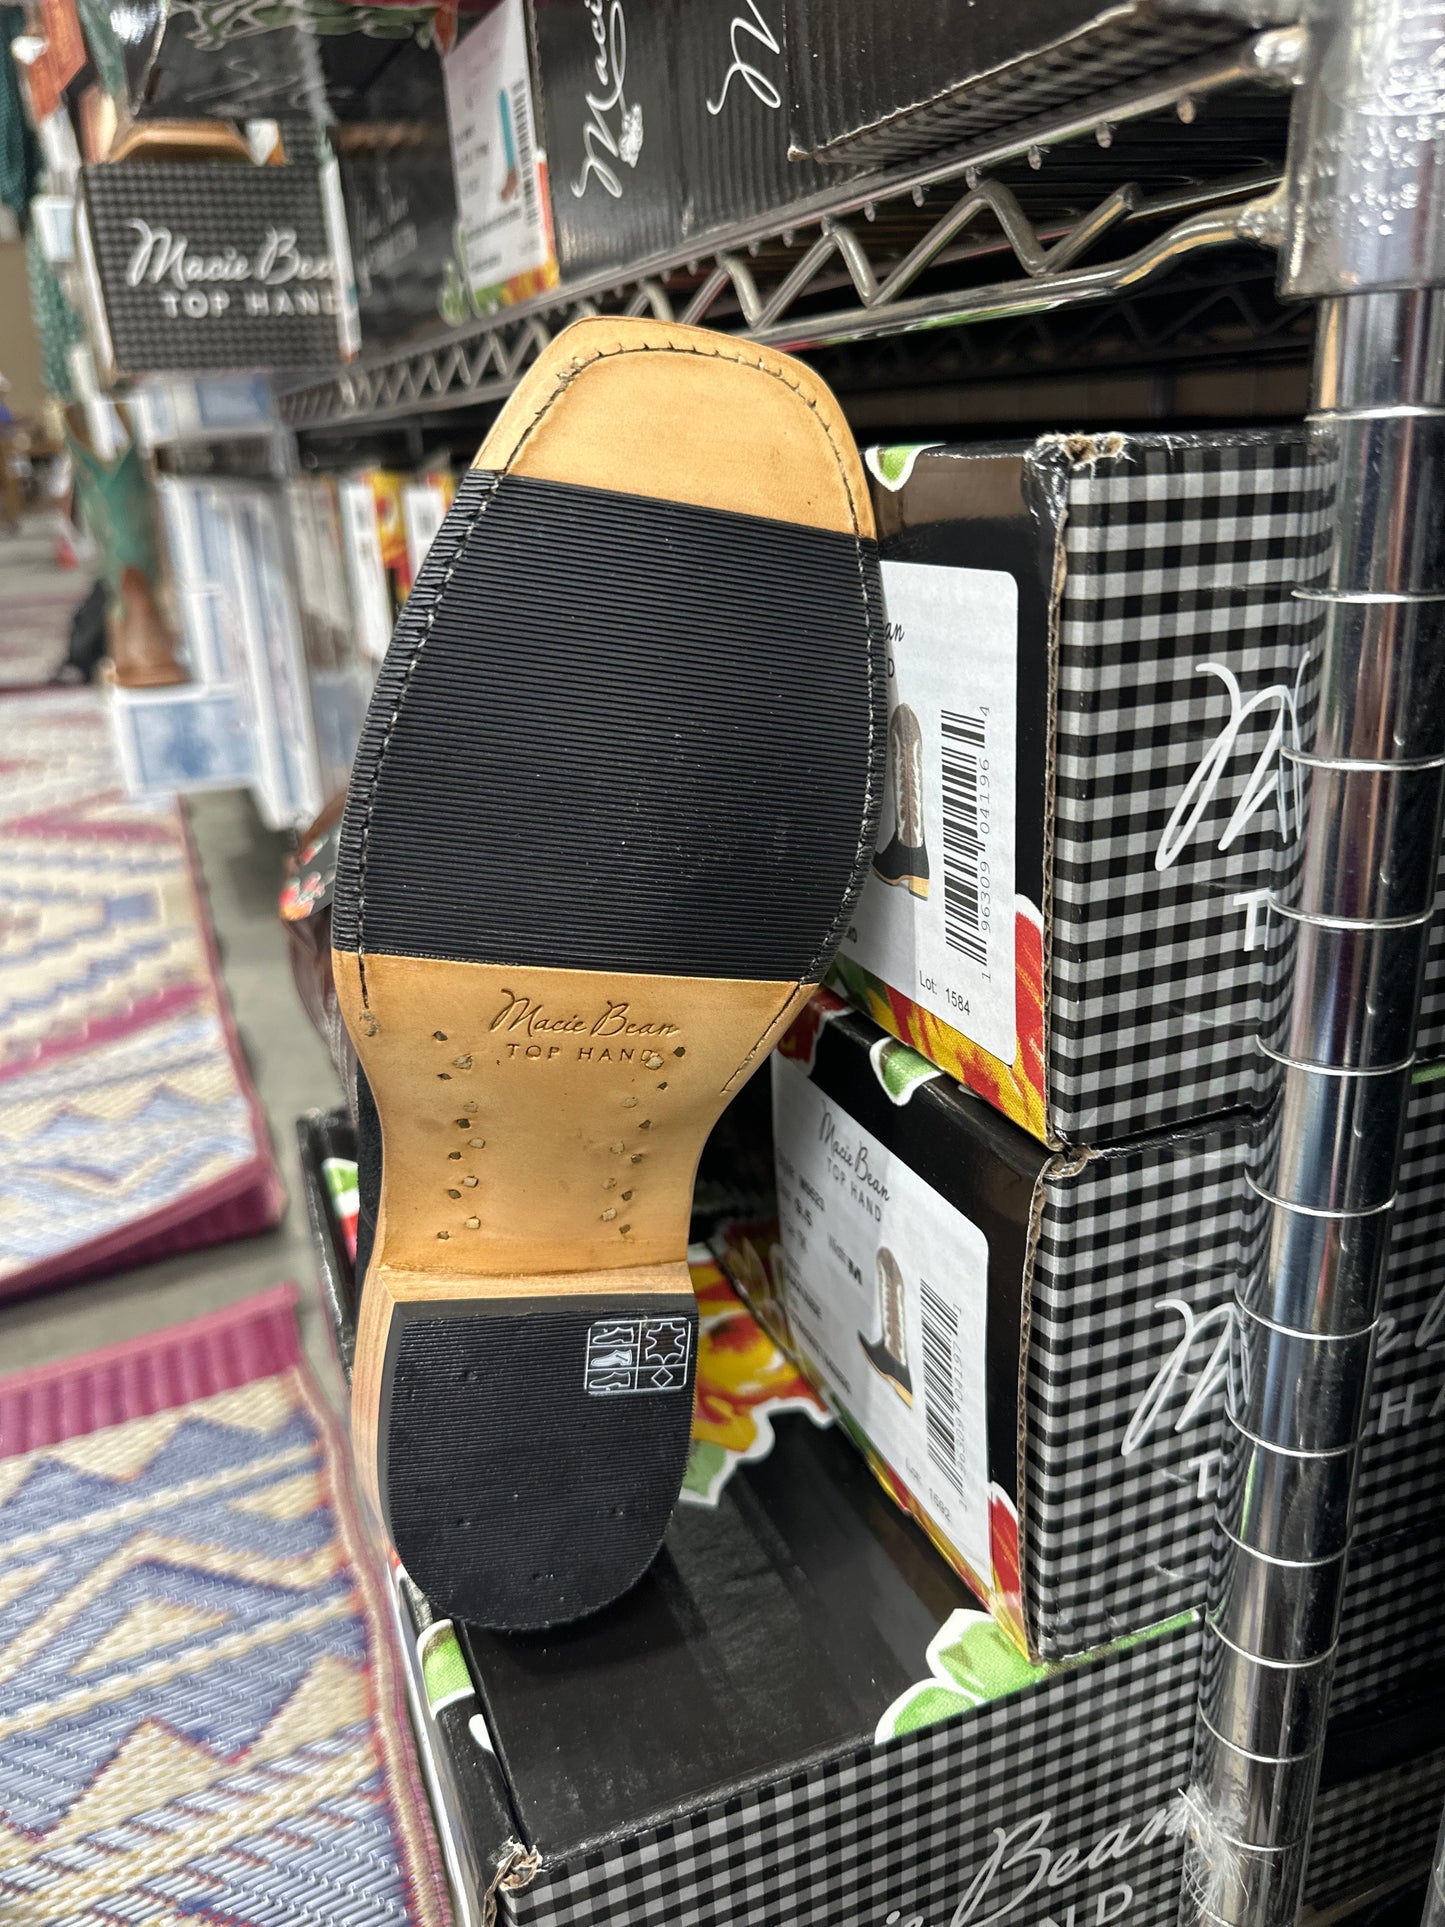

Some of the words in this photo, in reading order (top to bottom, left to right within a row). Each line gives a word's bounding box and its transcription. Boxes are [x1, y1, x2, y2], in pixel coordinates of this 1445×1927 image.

[126, 217, 251, 290] Macie
[253, 223, 338, 285] Bea
[159, 287, 230, 318] TOP
[489, 988, 587, 1037] Macie
[589, 1001, 680, 1037] Bean
[918, 970, 938, 995] Lot:
[945, 988, 971, 1015] 1584
[507, 1043, 560, 1060] TOP
[819, 1099, 853, 1167] Macie
[855, 1140, 890, 1201] Bean
[827, 1156, 846, 1186] TOP
[850, 1180, 882, 1222] HAND
